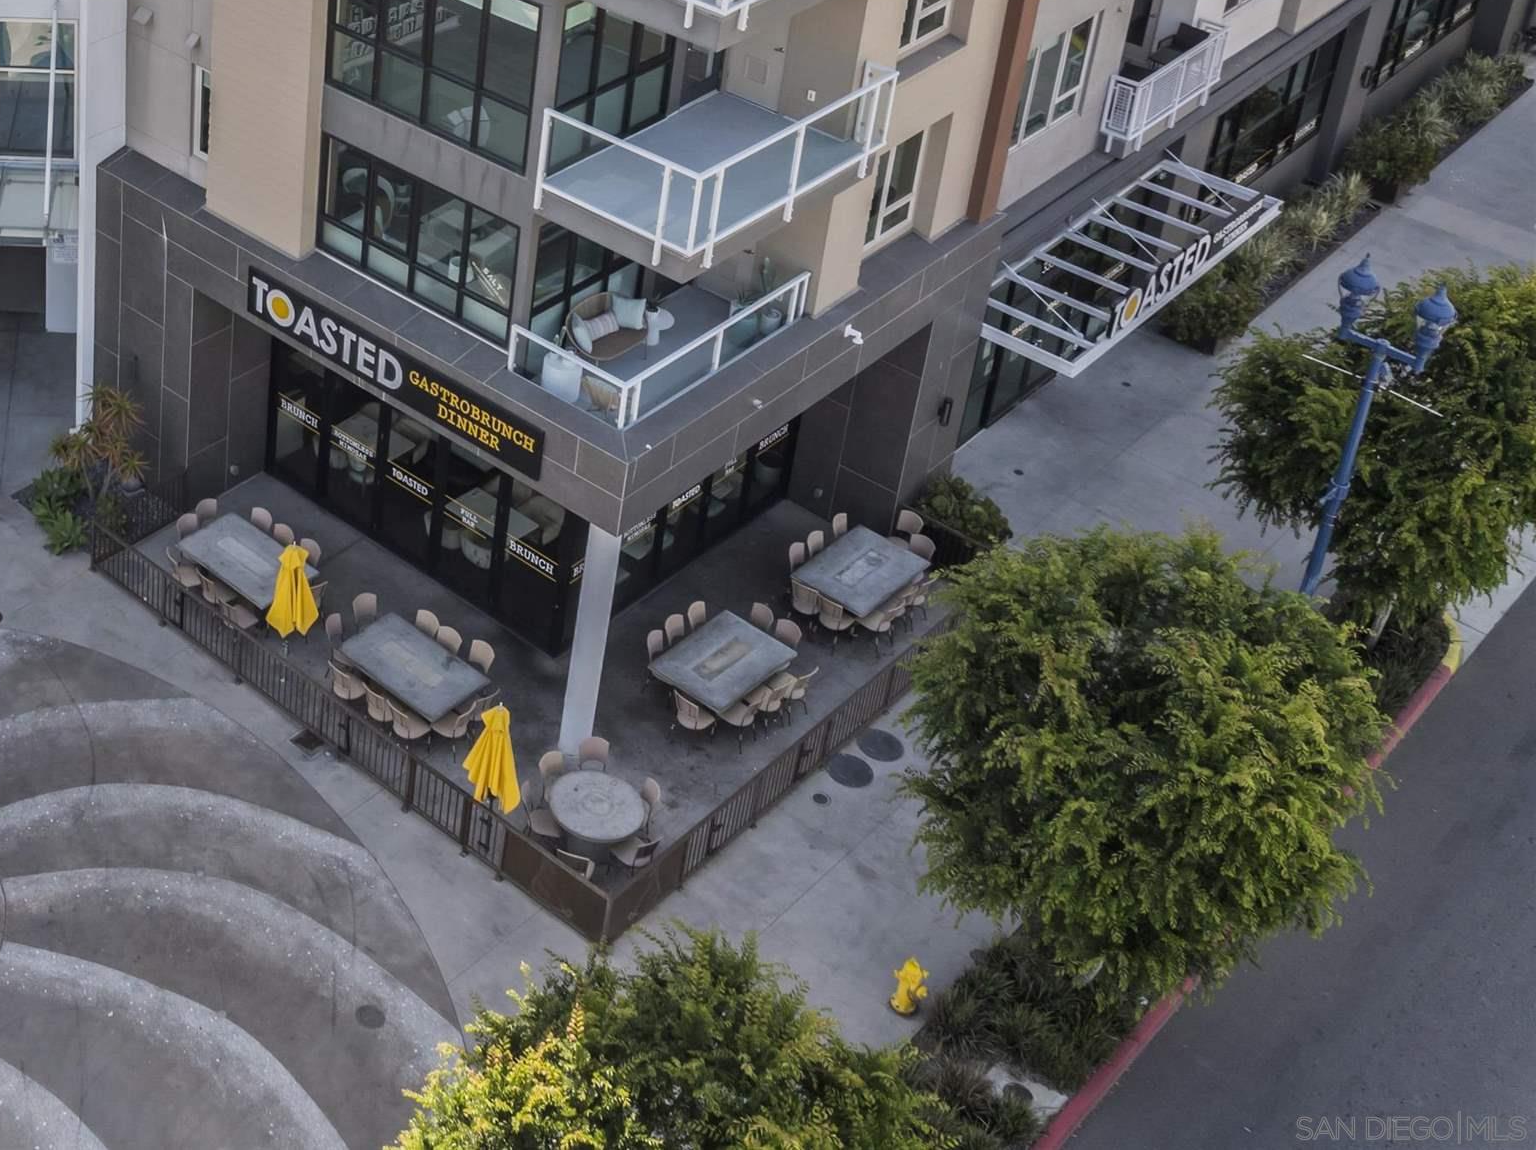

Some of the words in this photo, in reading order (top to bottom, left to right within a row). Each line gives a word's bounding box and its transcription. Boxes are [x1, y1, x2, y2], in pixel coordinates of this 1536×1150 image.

[1111, 234, 1212, 338] TOASTED
[252, 276, 403, 390] TOASTED
[280, 398, 319, 429] BRUNCH
[408, 370, 536, 453] GASTROBRUNCH
[438, 404, 502, 452] DINNER
[391, 467, 429, 497] TOASTED
[509, 540, 555, 576] BRUNCH
